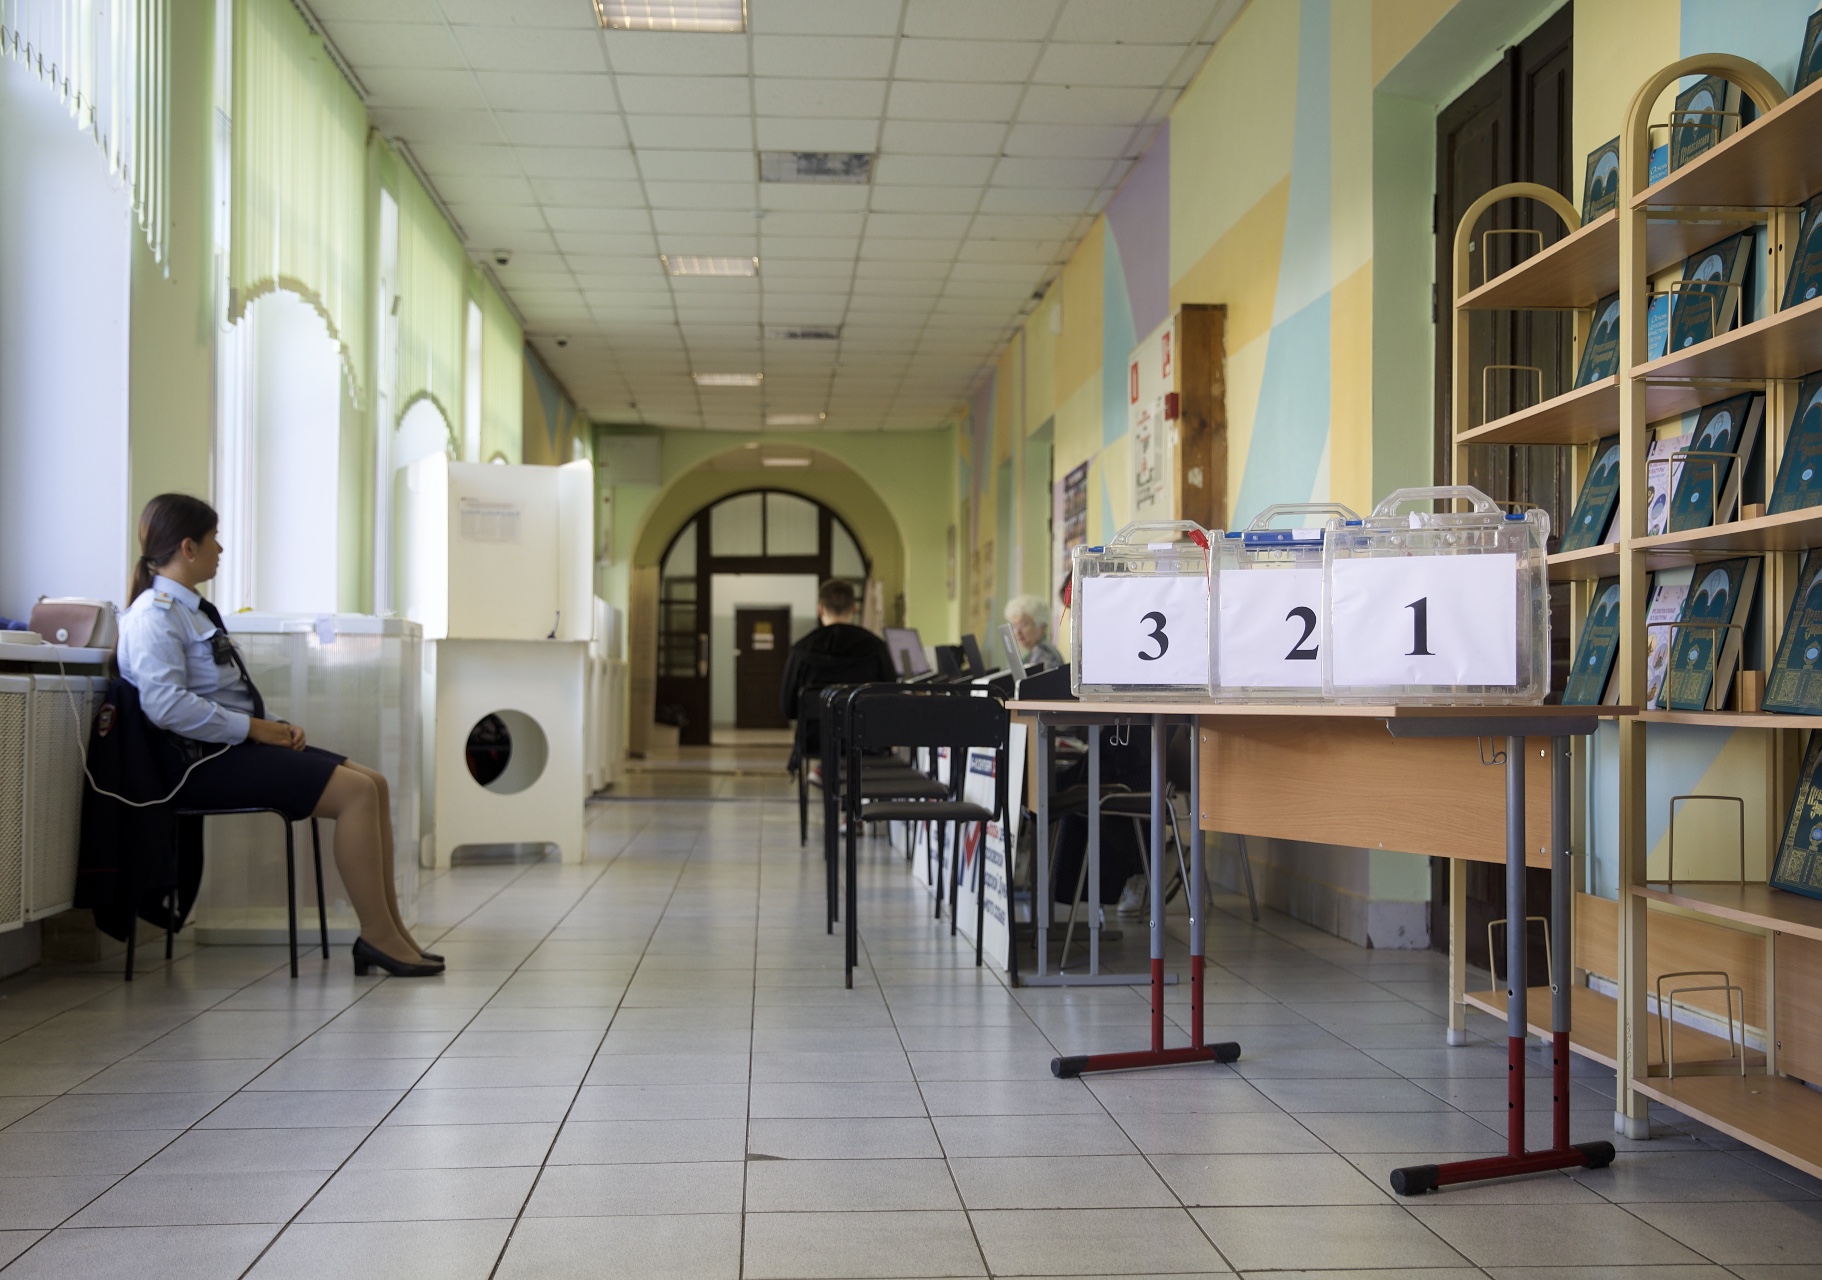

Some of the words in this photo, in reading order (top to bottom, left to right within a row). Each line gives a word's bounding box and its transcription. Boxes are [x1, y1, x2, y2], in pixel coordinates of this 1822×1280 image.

[1138, 611, 1169, 661] 3
[1285, 606, 1320, 661] 2
[1405, 596, 1436, 656] 1
